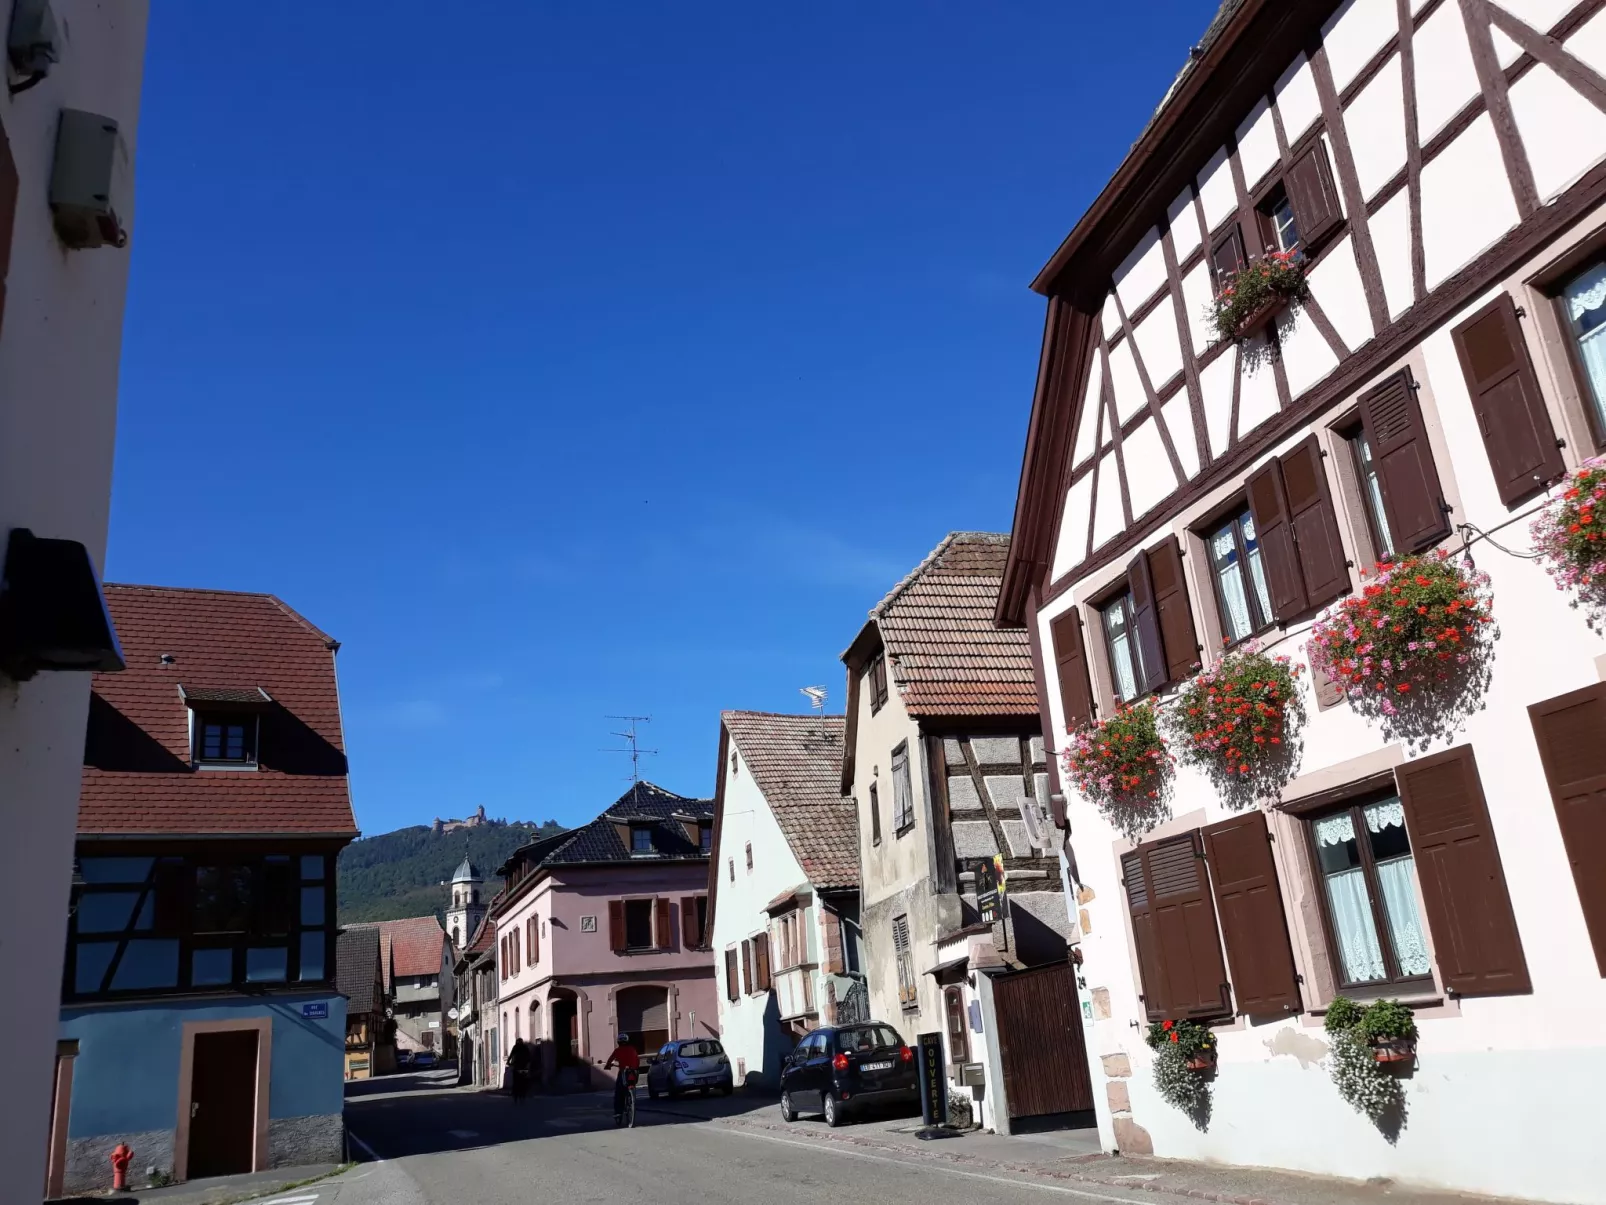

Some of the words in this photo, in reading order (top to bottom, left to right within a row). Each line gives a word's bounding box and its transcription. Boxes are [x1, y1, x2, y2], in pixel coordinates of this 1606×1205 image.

[1077, 976, 1087, 990] 24
[923, 1037, 938, 1046] CAVE
[928, 1048, 939, 1119] OUVERTE
